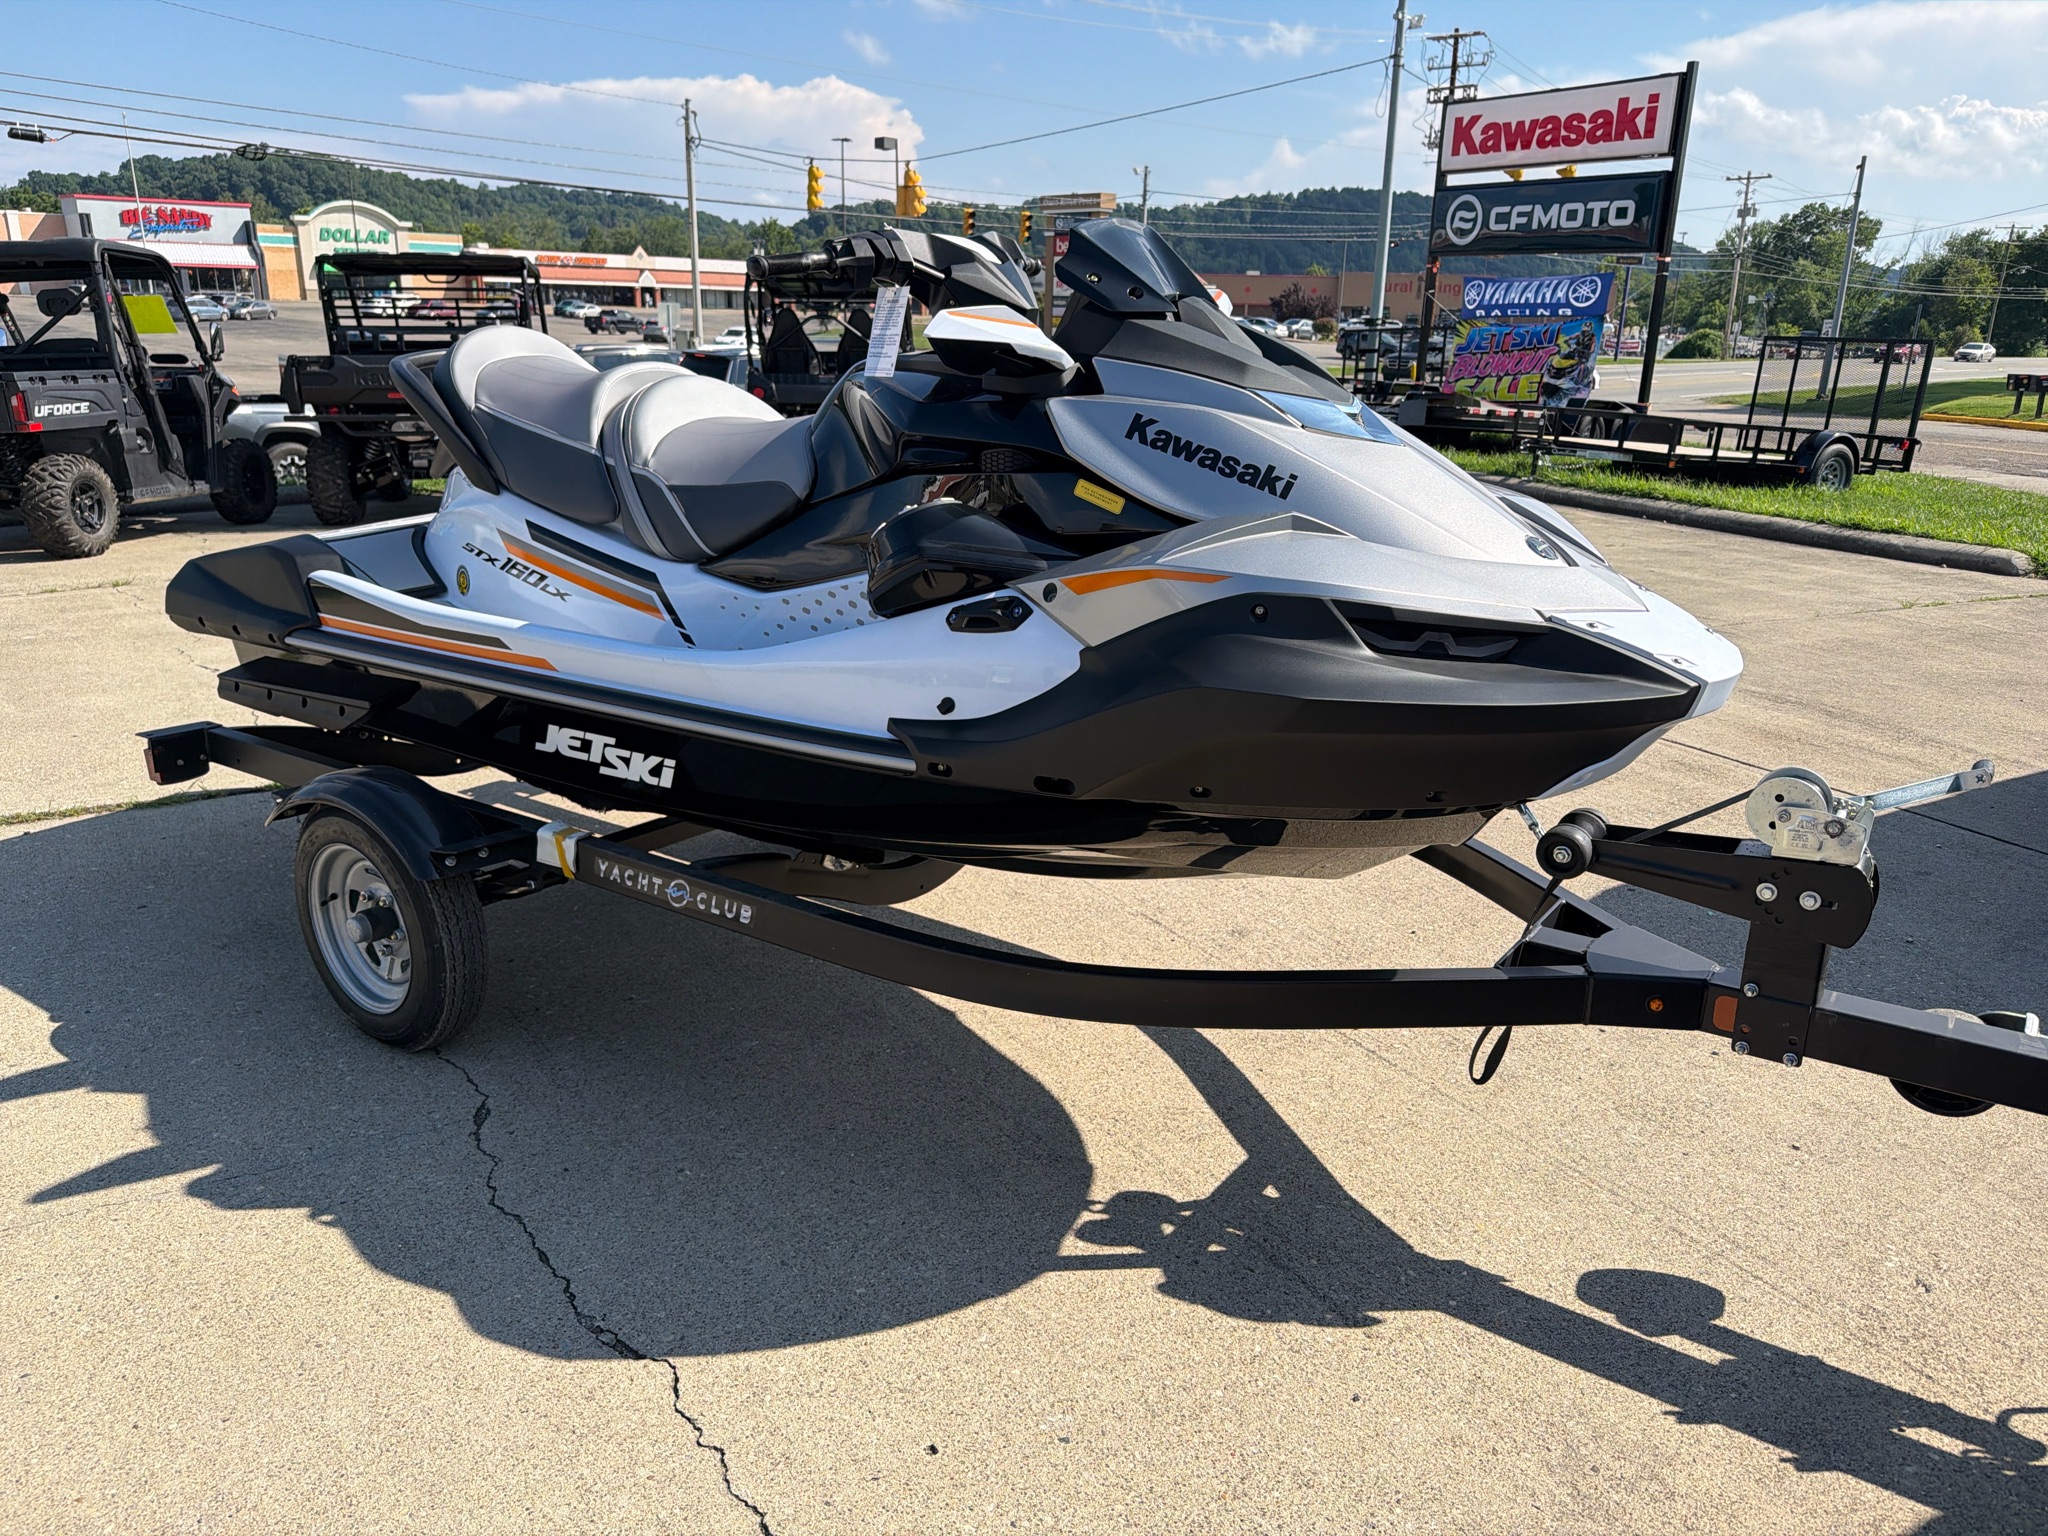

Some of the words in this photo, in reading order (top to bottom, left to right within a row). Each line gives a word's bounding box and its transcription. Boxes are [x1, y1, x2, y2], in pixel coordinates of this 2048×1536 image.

[1451, 93, 1661, 157] Kawasaki
[121, 205, 154, 225] BIG
[157, 206, 213, 229] SANDY
[1489, 200, 1636, 231] CFMOTO
[319, 227, 390, 245] DOLLAR
[1385, 281, 1414, 293] ural
[1438, 282, 1462, 297] ing
[1483, 279, 1572, 305] YAMAHA
[1475, 308, 1573, 317] RACING
[1455, 326, 1513, 355] JET
[1508, 323, 1562, 349] SKI
[1450, 347, 1560, 382] BLOWOUT
[1454, 373, 1543, 402] SALE
[34, 402, 90, 418] UFORCE
[1124, 412, 1299, 501] Kawasaki
[597, 859, 664, 896] YACHT
[696, 892, 753, 924] CLUB
